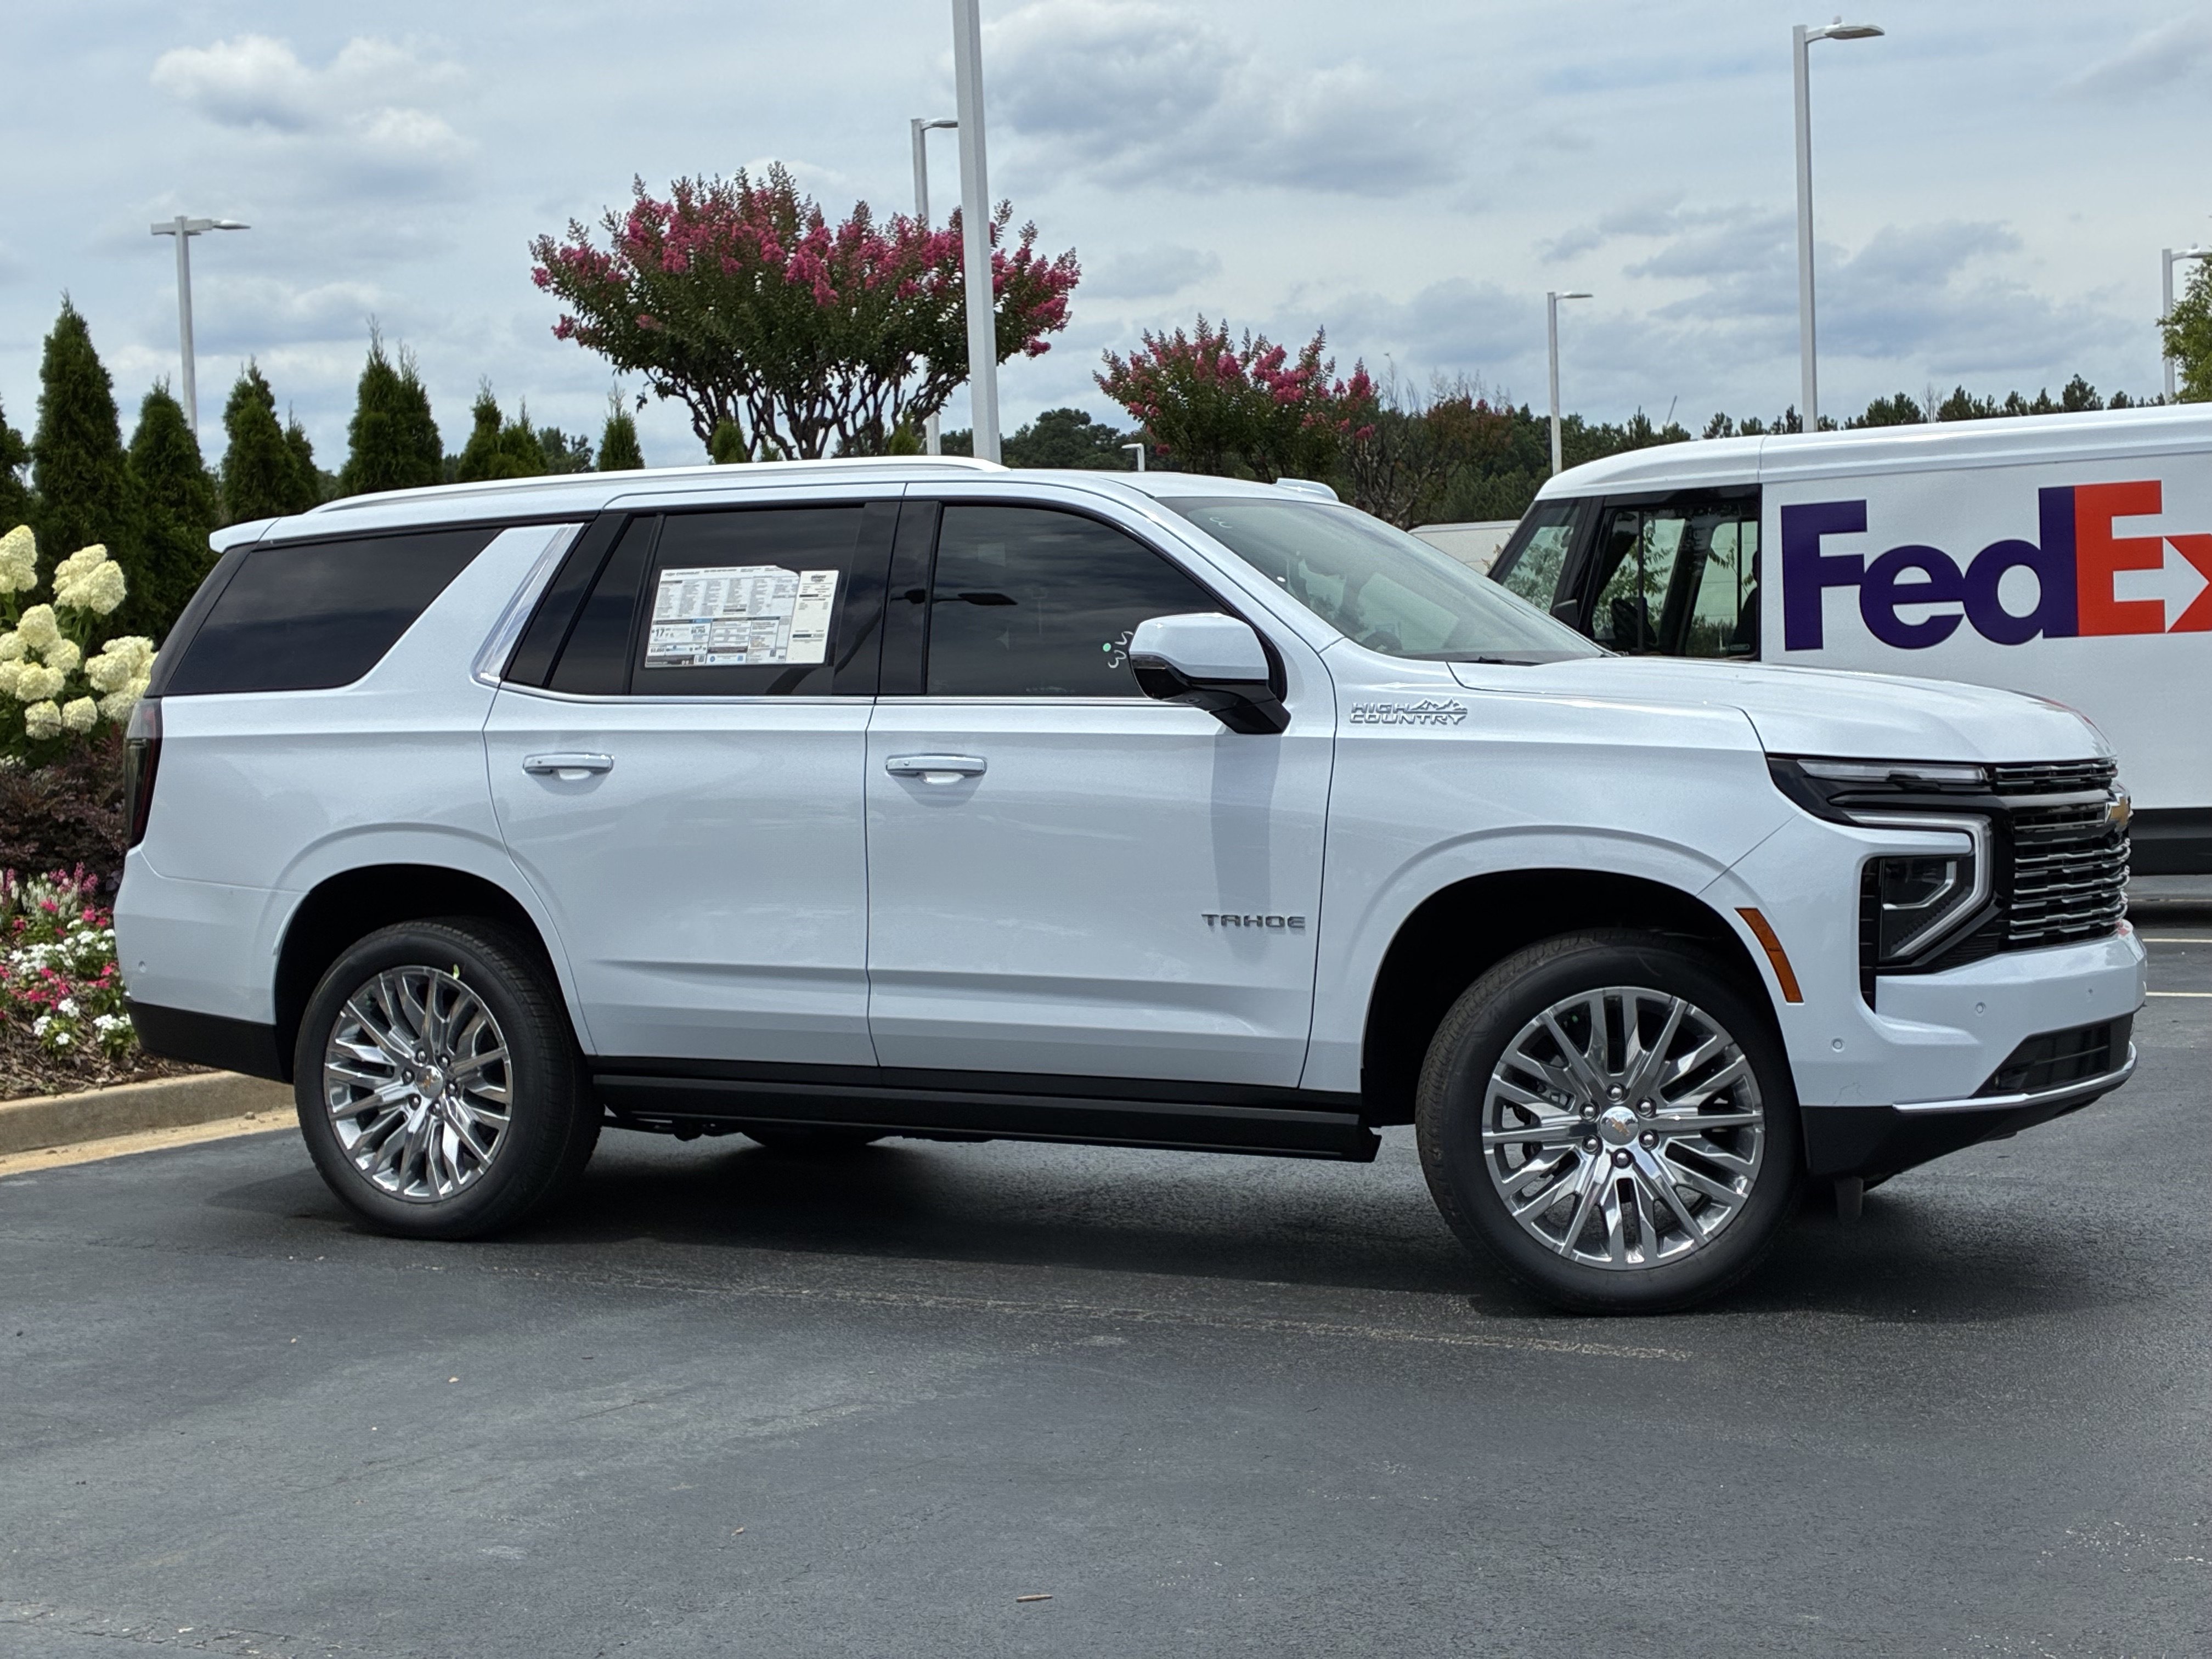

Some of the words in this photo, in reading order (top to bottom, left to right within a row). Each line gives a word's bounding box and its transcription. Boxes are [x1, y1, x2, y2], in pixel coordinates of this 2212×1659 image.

[1351, 702, 1410, 713] HIGH
[1349, 713, 1467, 725] COUNTRY
[1201, 913, 1306, 928] TAHOE
